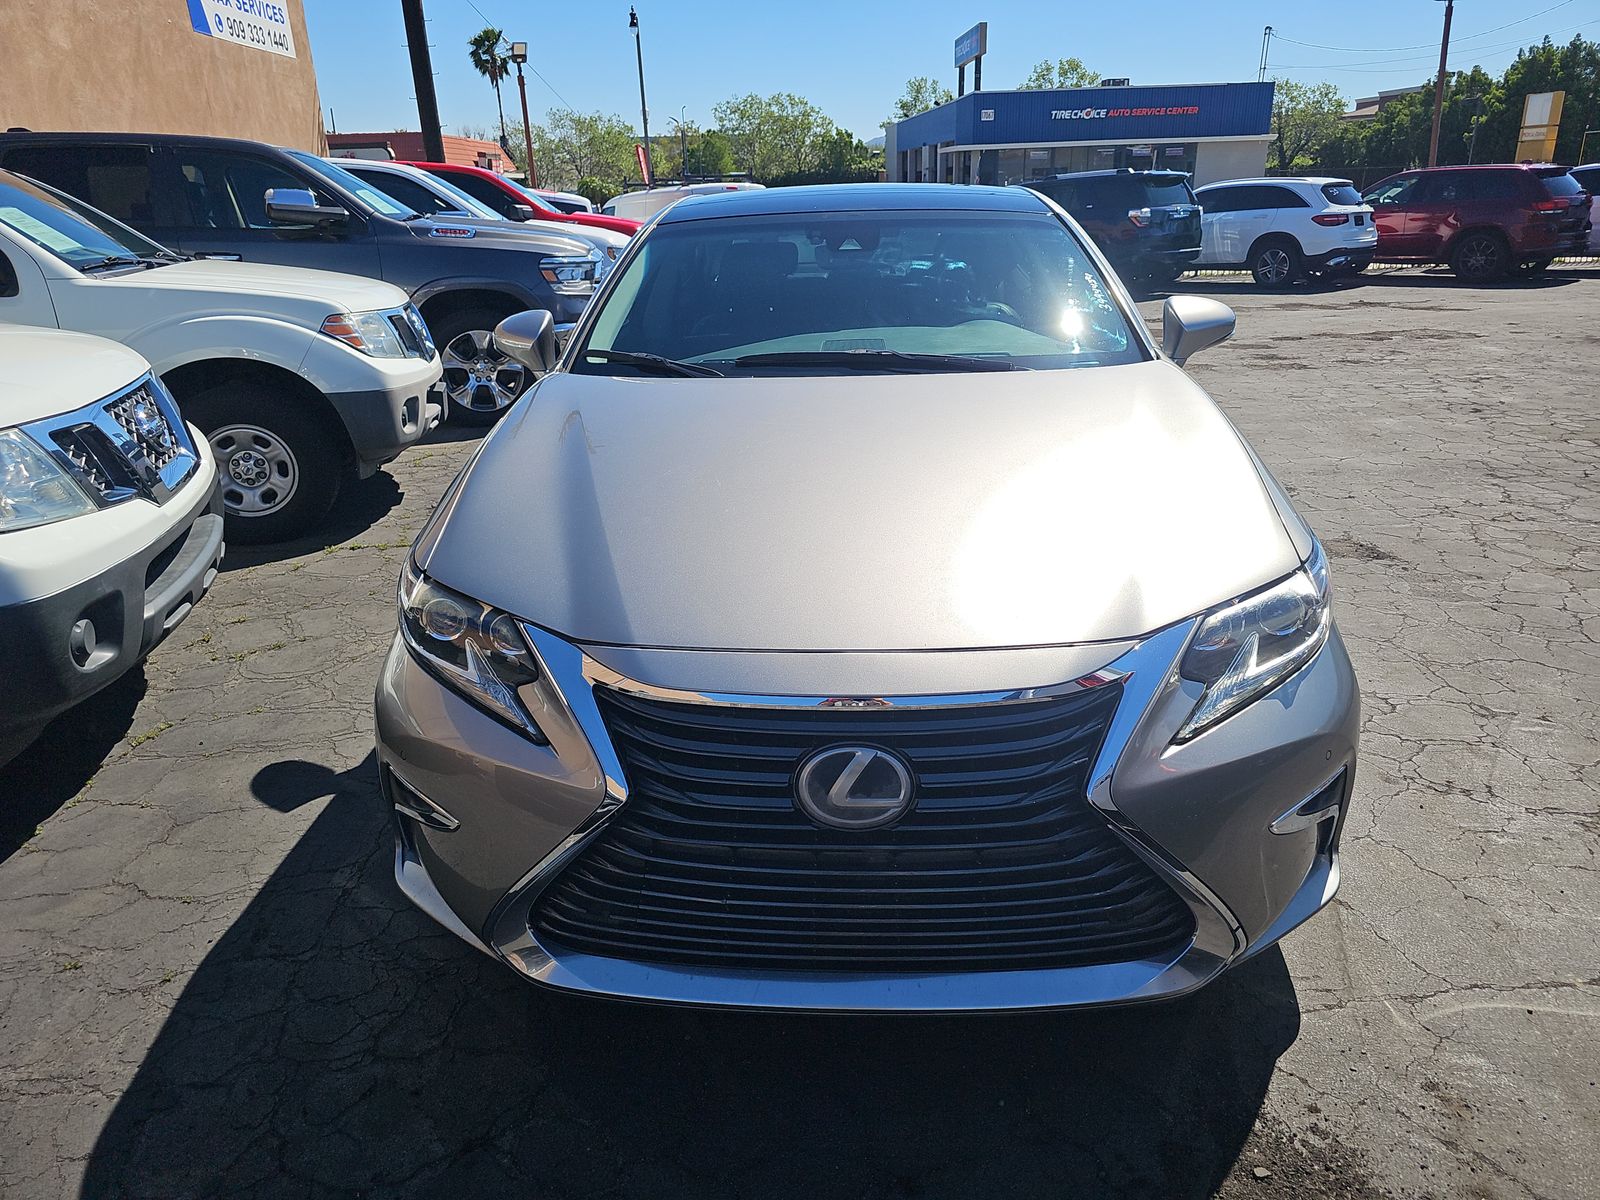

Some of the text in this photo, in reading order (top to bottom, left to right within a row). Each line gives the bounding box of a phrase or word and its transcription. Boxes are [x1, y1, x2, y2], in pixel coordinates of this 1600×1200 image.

[235, 0, 285, 24] SERVICES
[226, 17, 289, 51] 909 333 1440
[1108, 109, 1131, 118] AUTO
[1131, 107, 1166, 116] SERVICE
[1166, 106, 1199, 115] CENTER
